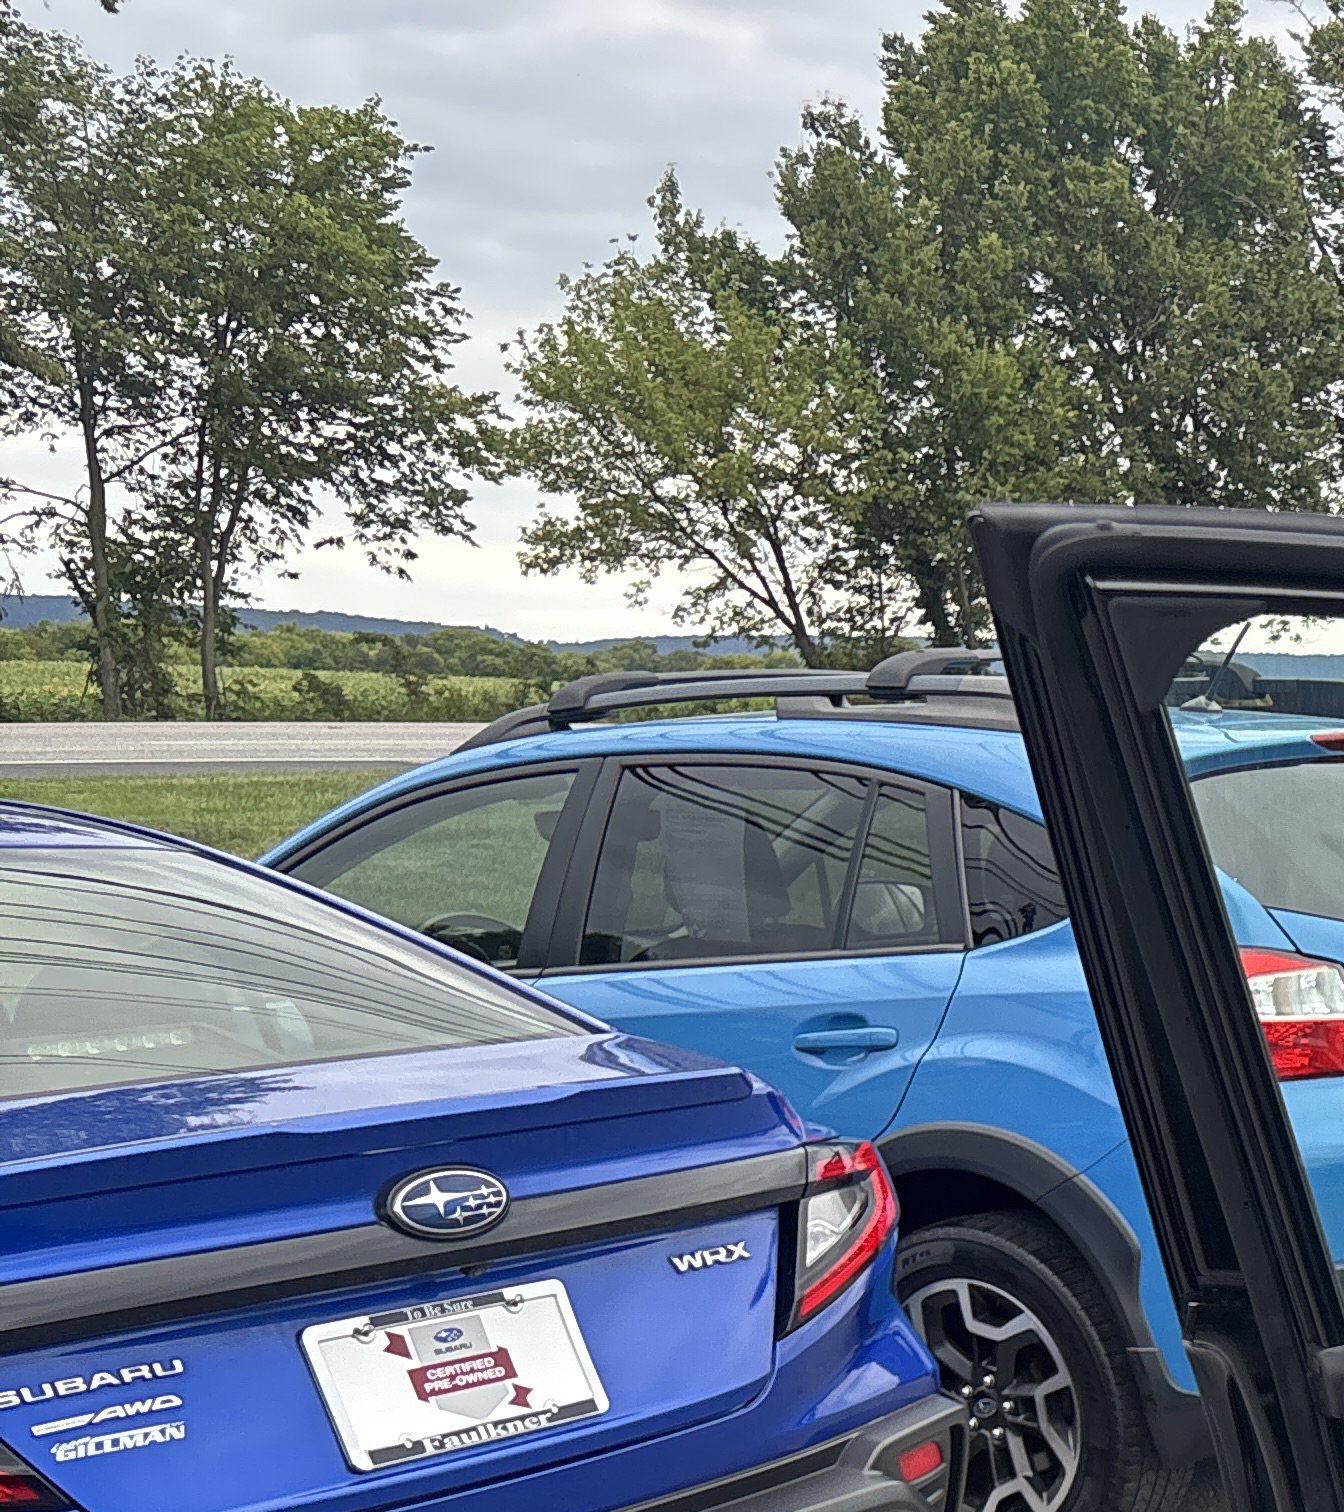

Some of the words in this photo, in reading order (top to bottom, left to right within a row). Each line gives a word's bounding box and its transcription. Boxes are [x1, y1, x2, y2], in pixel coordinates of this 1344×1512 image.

[669, 1240, 751, 1273] WRX
[403, 1308, 422, 1322] To
[424, 1304, 441, 1318] Be
[443, 1298, 474, 1314] Sure
[433, 1341, 473, 1356] SUBARU
[424, 1367, 506, 1394] PRE-OWNED
[426, 1356, 496, 1380] CERTIFIED
[0, 1358, 185, 1410] SUBARU
[91, 1394, 183, 1424] AWD
[56, 1423, 186, 1462] GILLMAN
[422, 1410, 554, 1453] Faulkner
